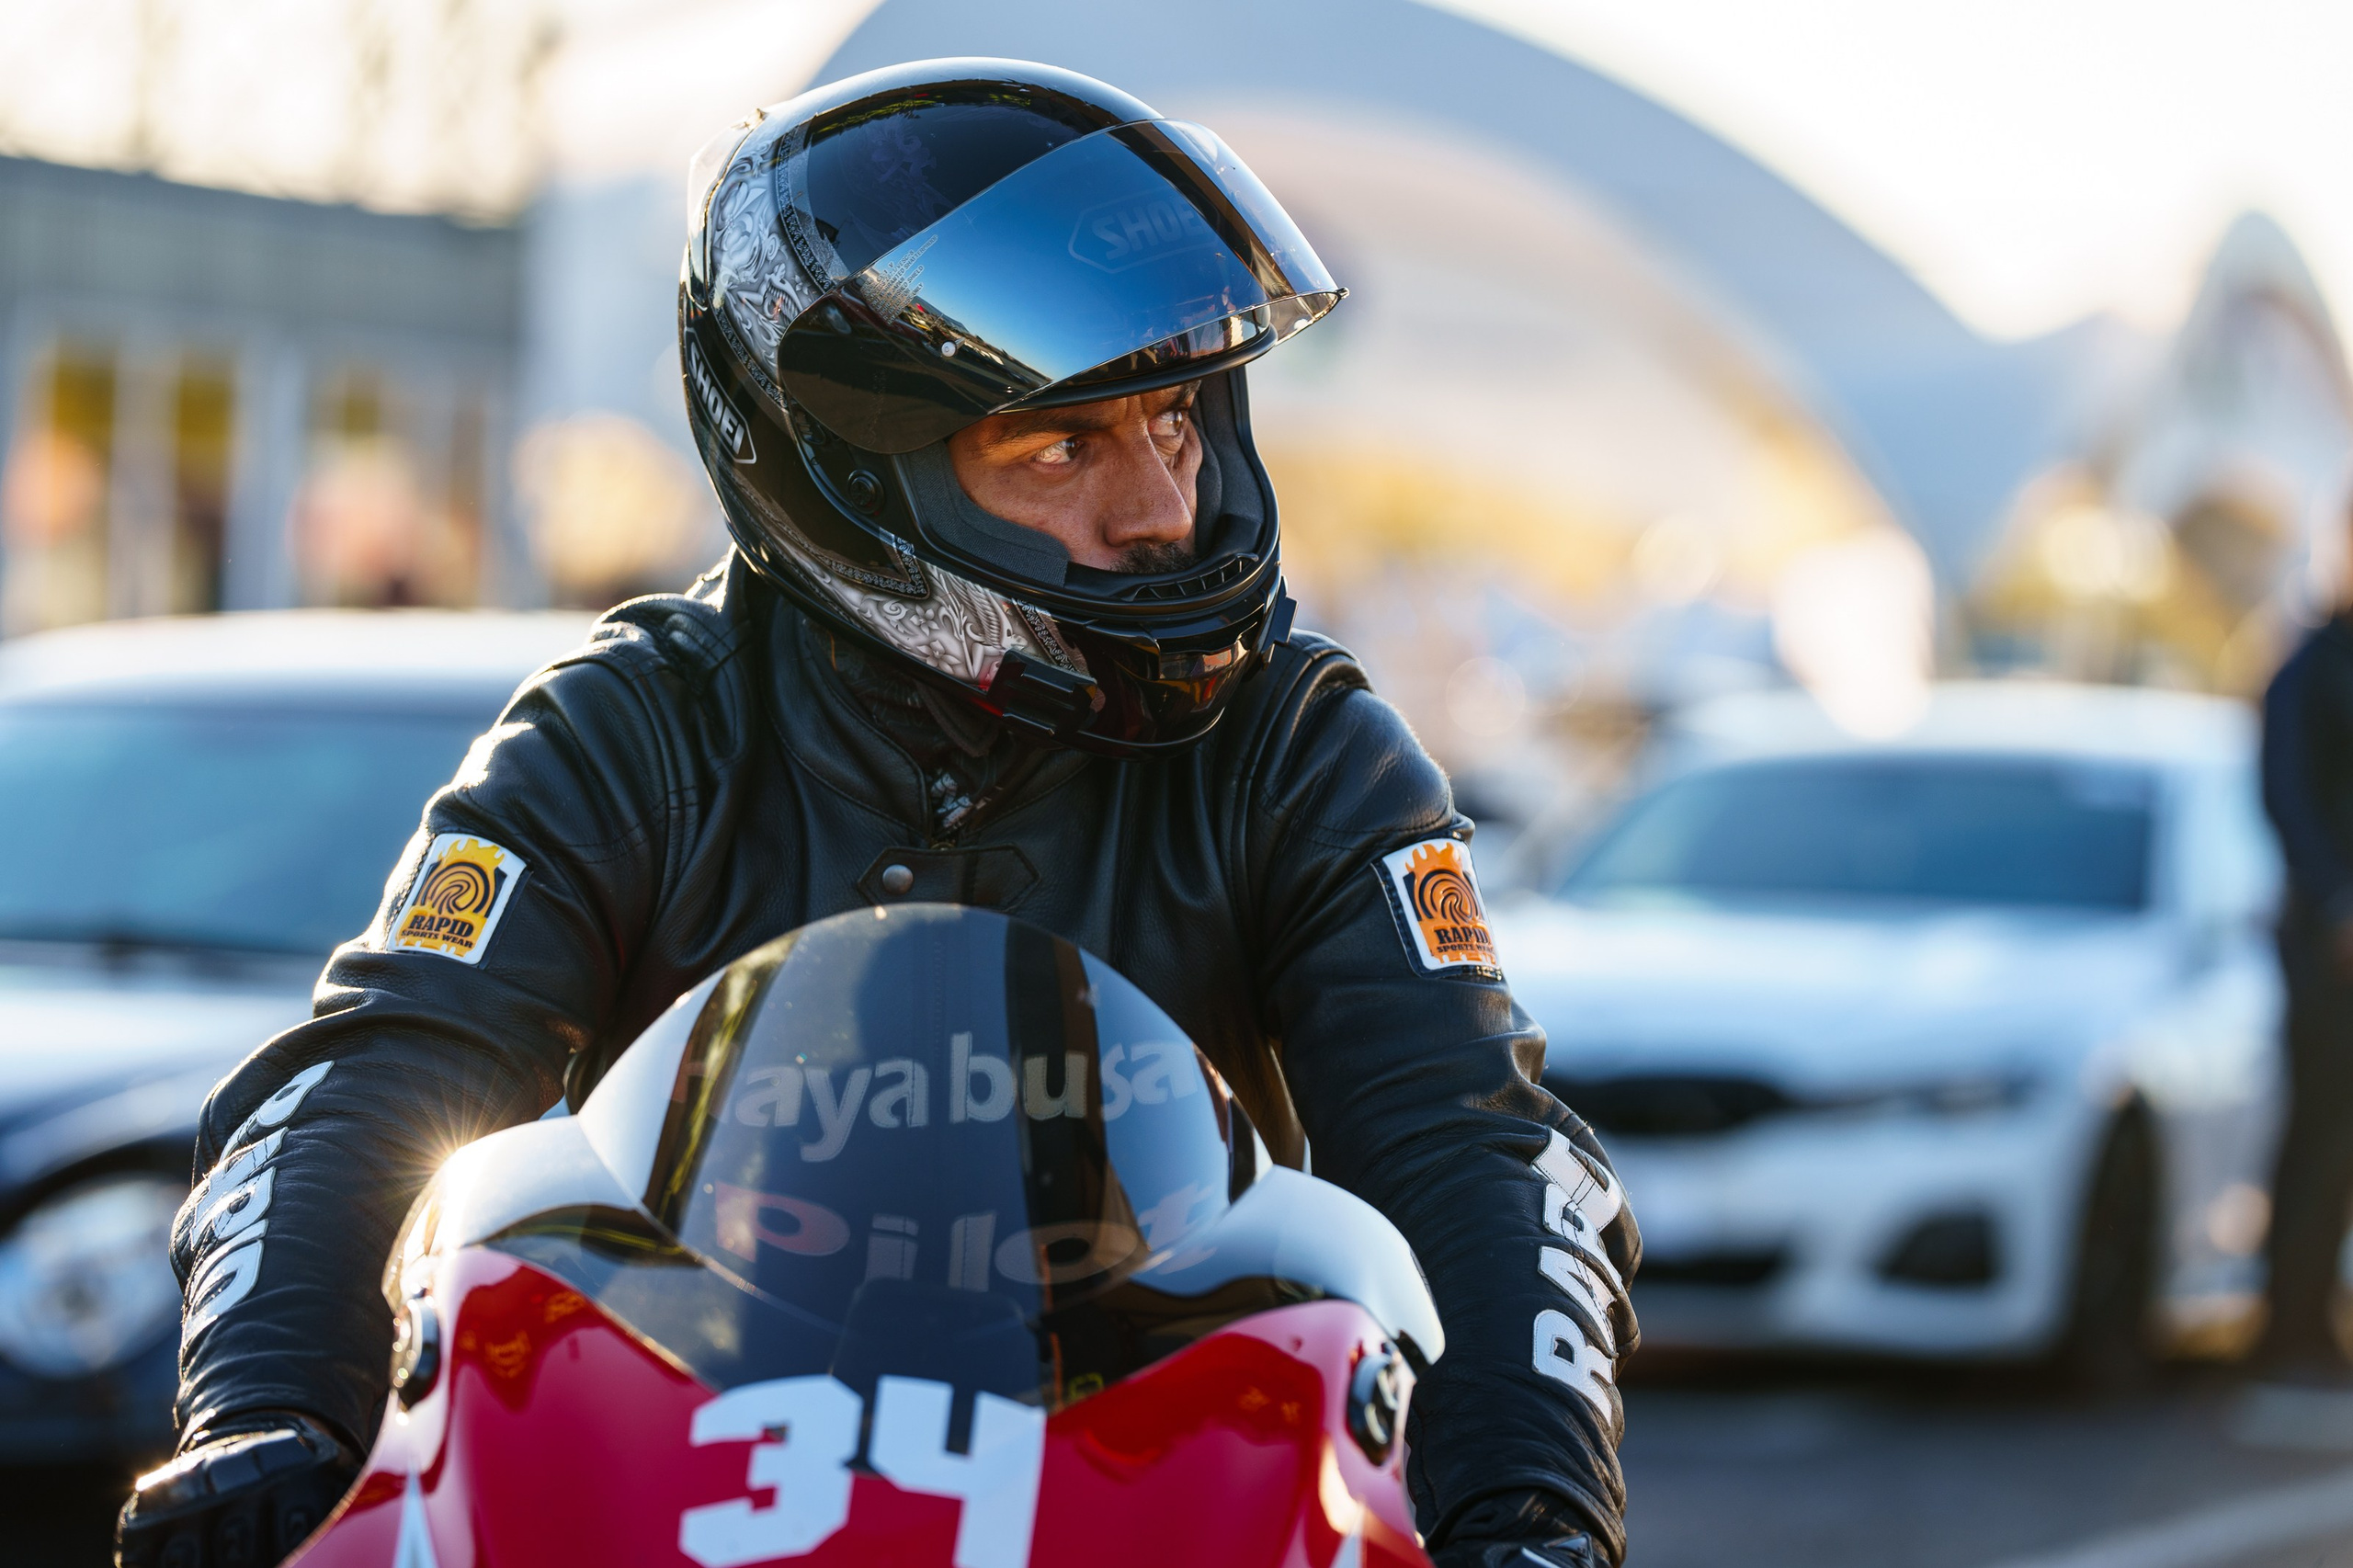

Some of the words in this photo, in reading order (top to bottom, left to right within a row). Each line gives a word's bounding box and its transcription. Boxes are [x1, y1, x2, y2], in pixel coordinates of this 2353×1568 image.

[1092, 200, 1204, 260] SHOE
[907, 266, 924, 283] SHIELD
[689, 341, 745, 455] SHOEI
[408, 915, 474, 937] RAPID
[1434, 926, 1489, 945] RAPID
[402, 929, 438, 939] SPORTS
[442, 934, 474, 949] WEAR
[677, 1374, 1046, 1568] 34
